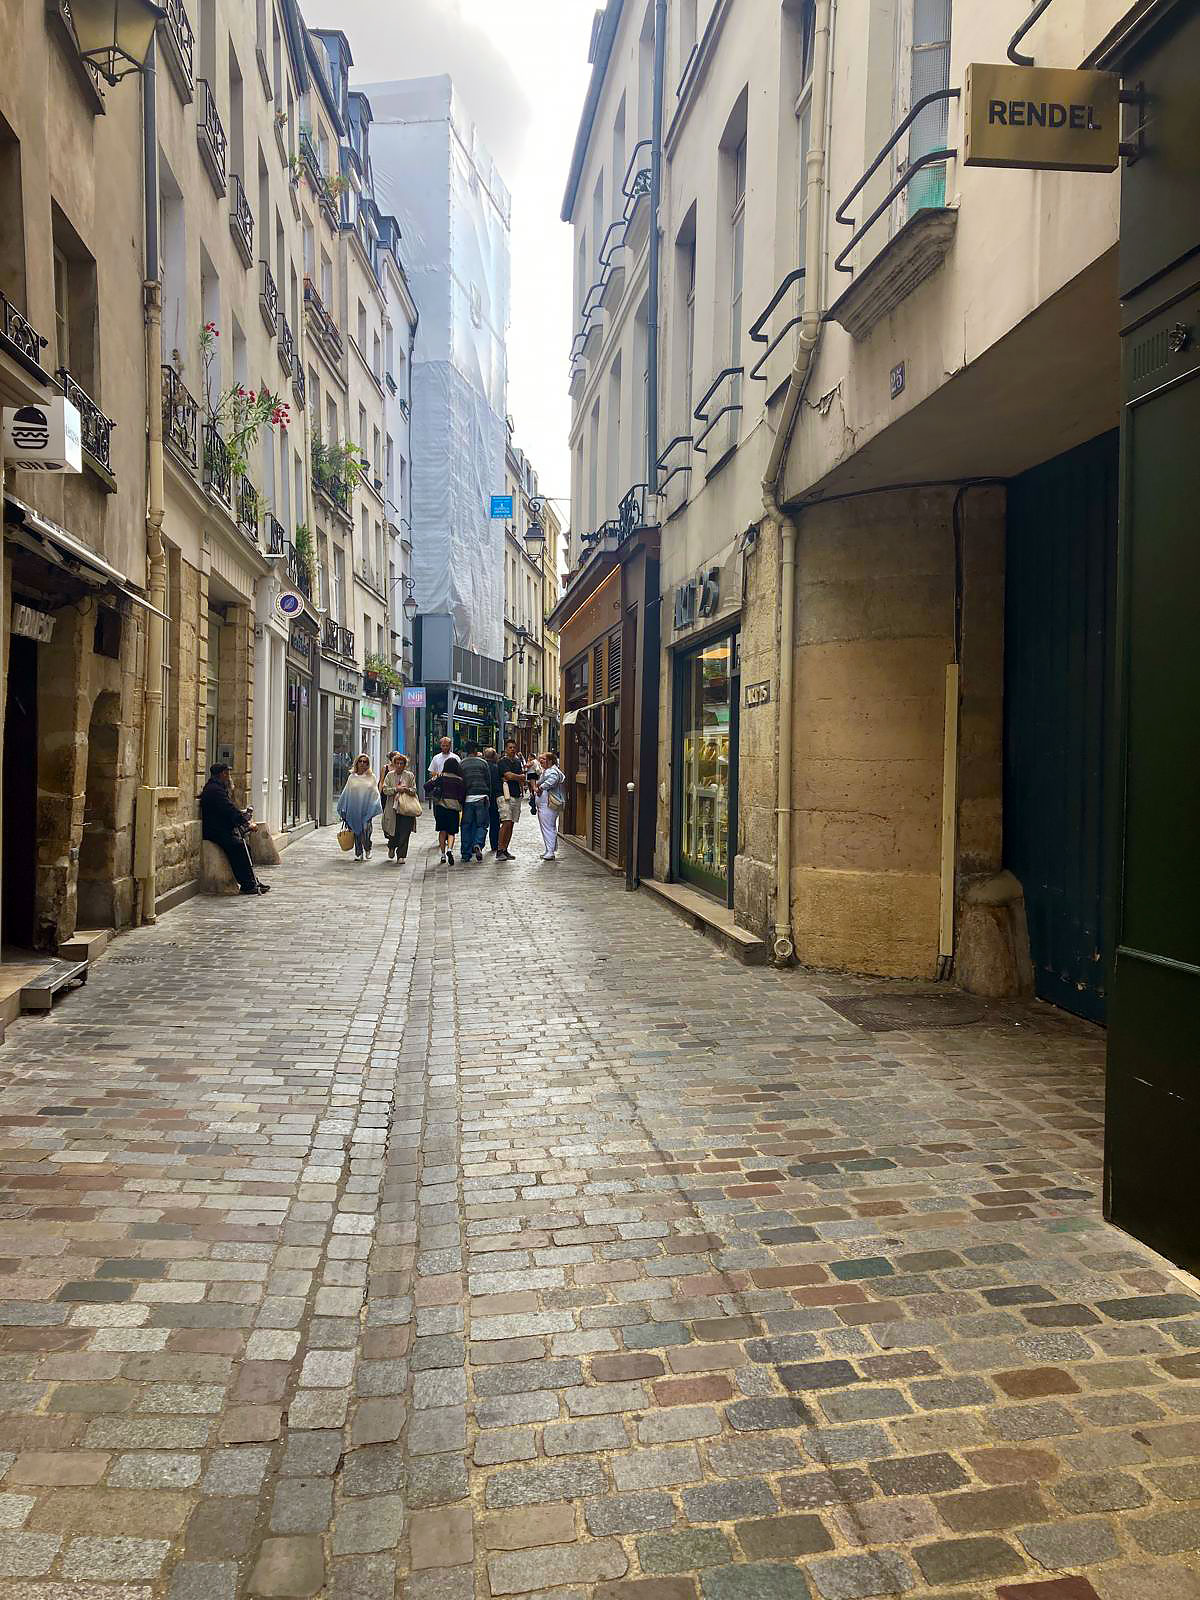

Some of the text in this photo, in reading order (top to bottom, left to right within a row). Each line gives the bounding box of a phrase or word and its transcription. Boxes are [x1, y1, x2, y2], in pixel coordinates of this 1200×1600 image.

[988, 99, 1102, 131] RENDEL
[890, 367, 904, 393] 25
[407, 690, 424, 702] Niji
